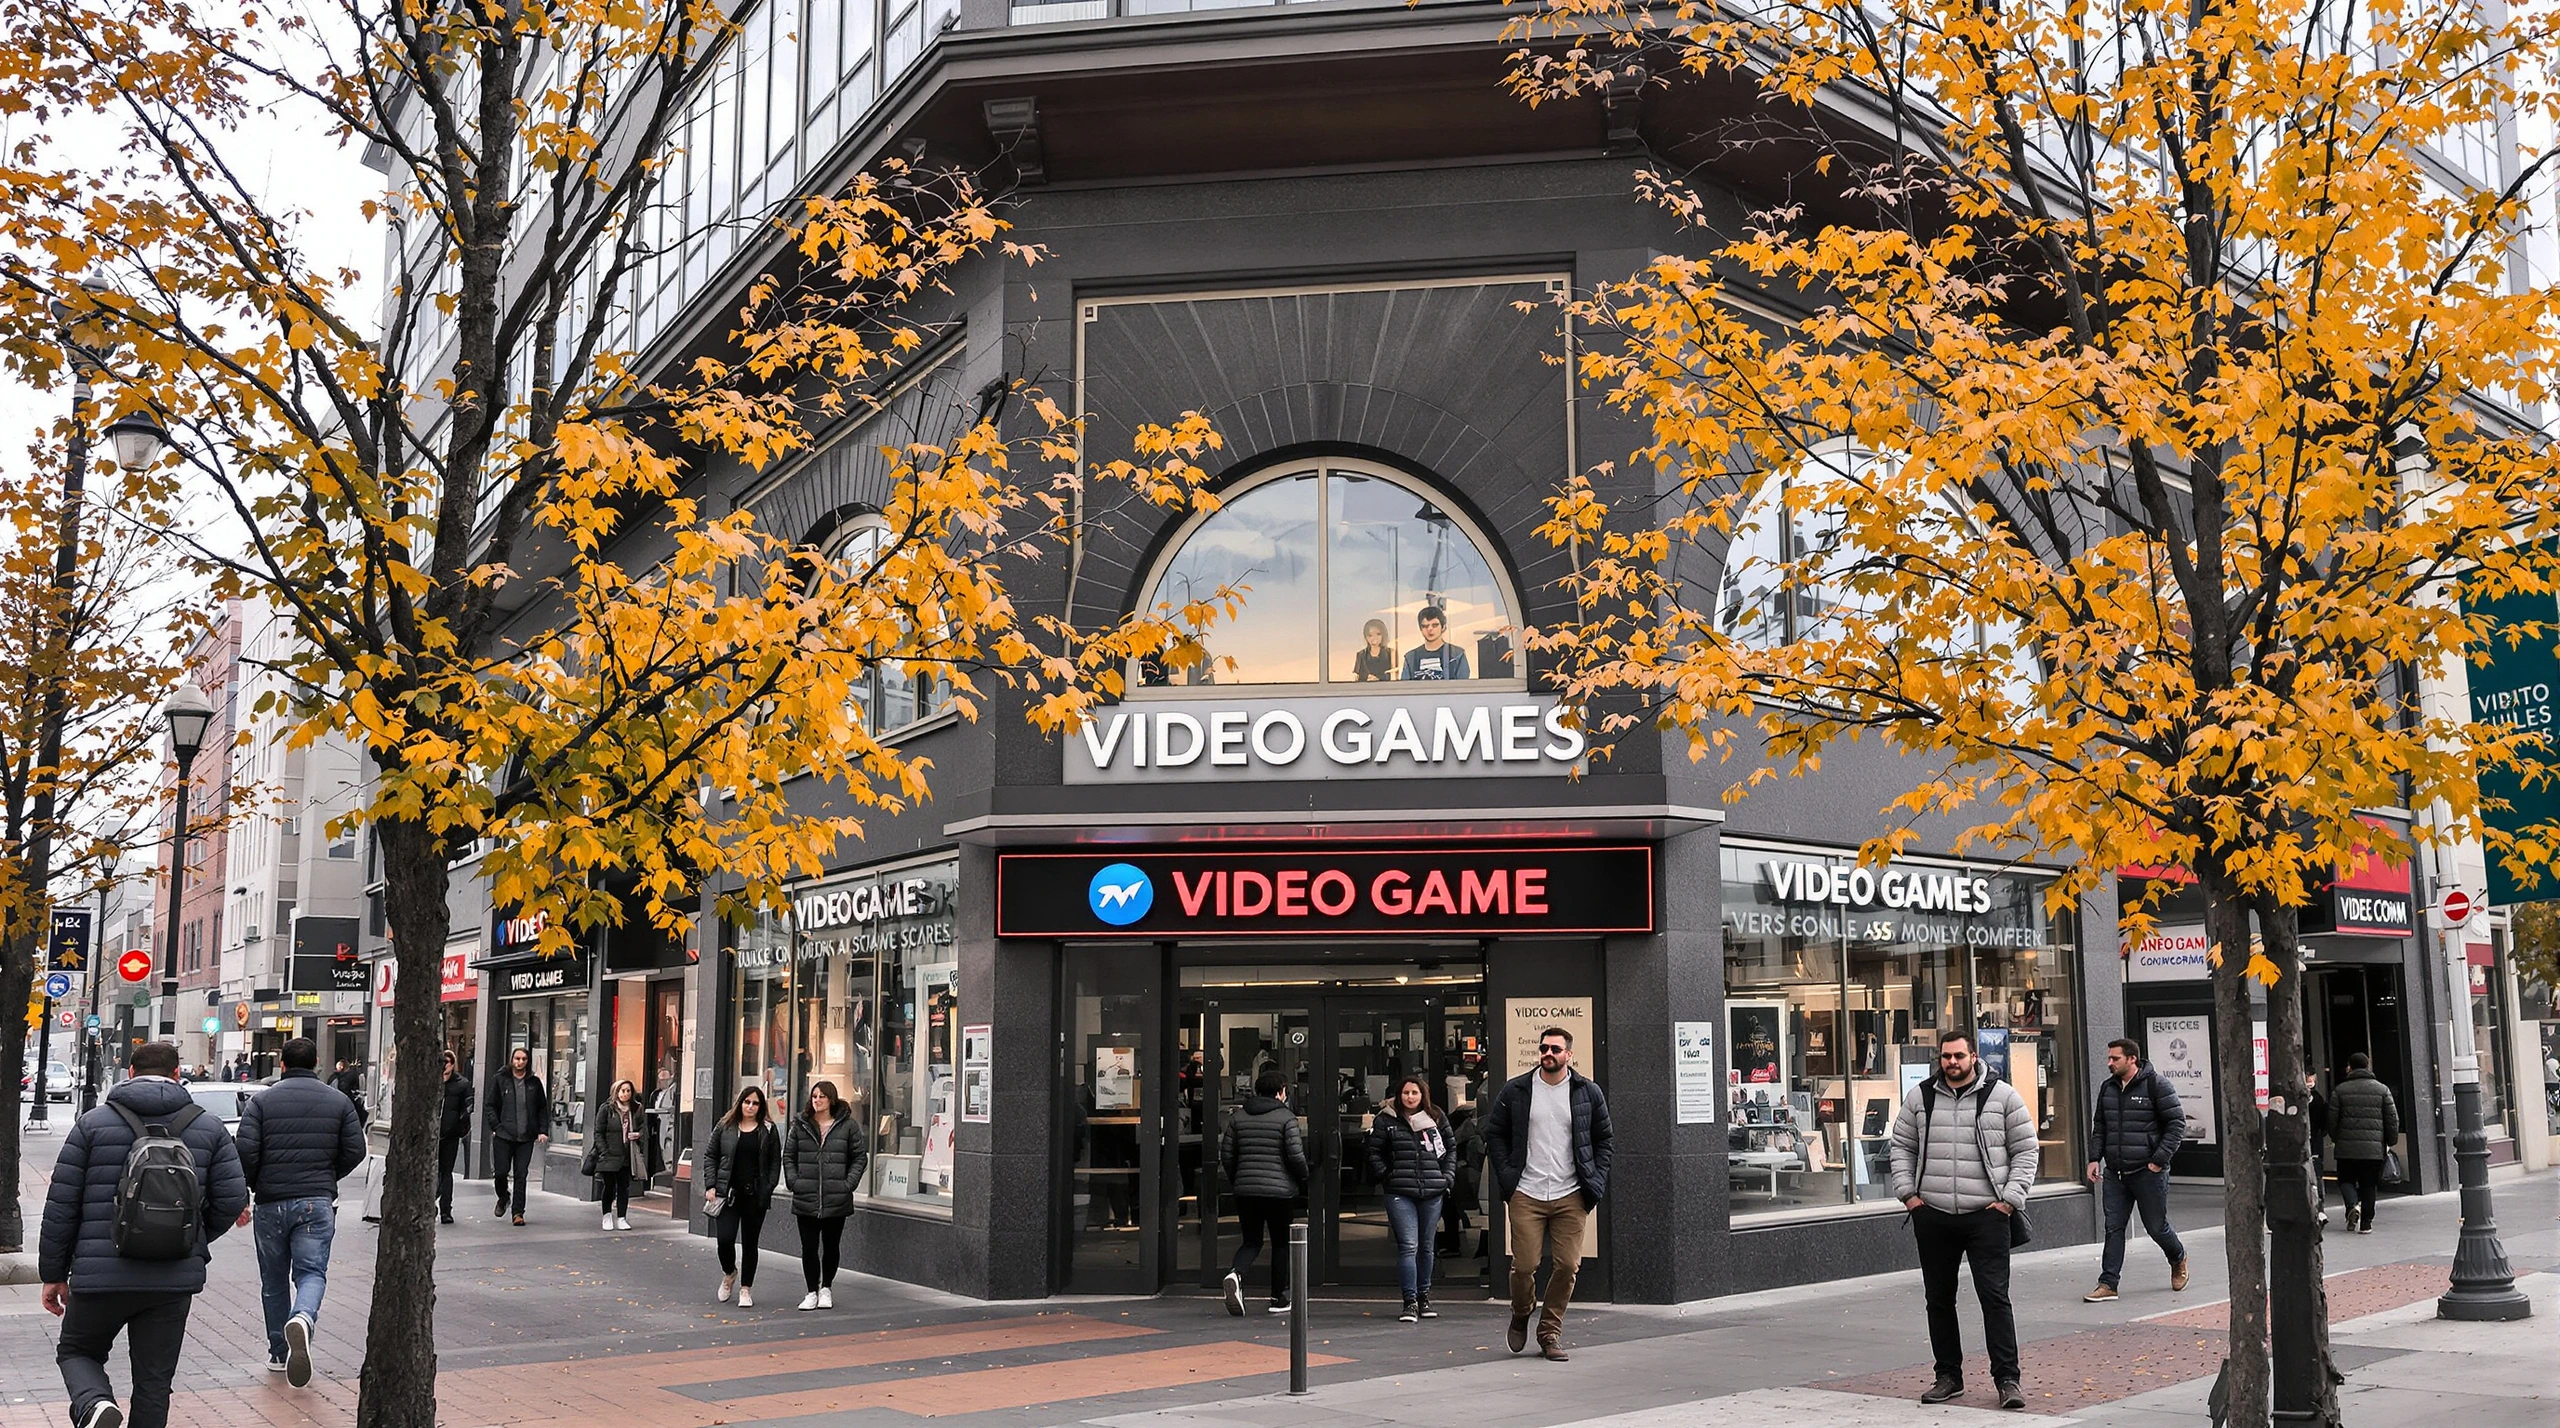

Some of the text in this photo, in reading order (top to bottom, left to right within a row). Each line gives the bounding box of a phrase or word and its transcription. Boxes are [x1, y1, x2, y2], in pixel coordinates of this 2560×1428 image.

[1077, 705, 1587, 768] VIDEO GAMES
[1172, 868, 1549, 917] VIDEO GAME
[1768, 860, 1991, 913] VIDEO GAMES
[1732, 911, 1787, 935] VERS
[1902, 923, 1960, 944] MONEY
